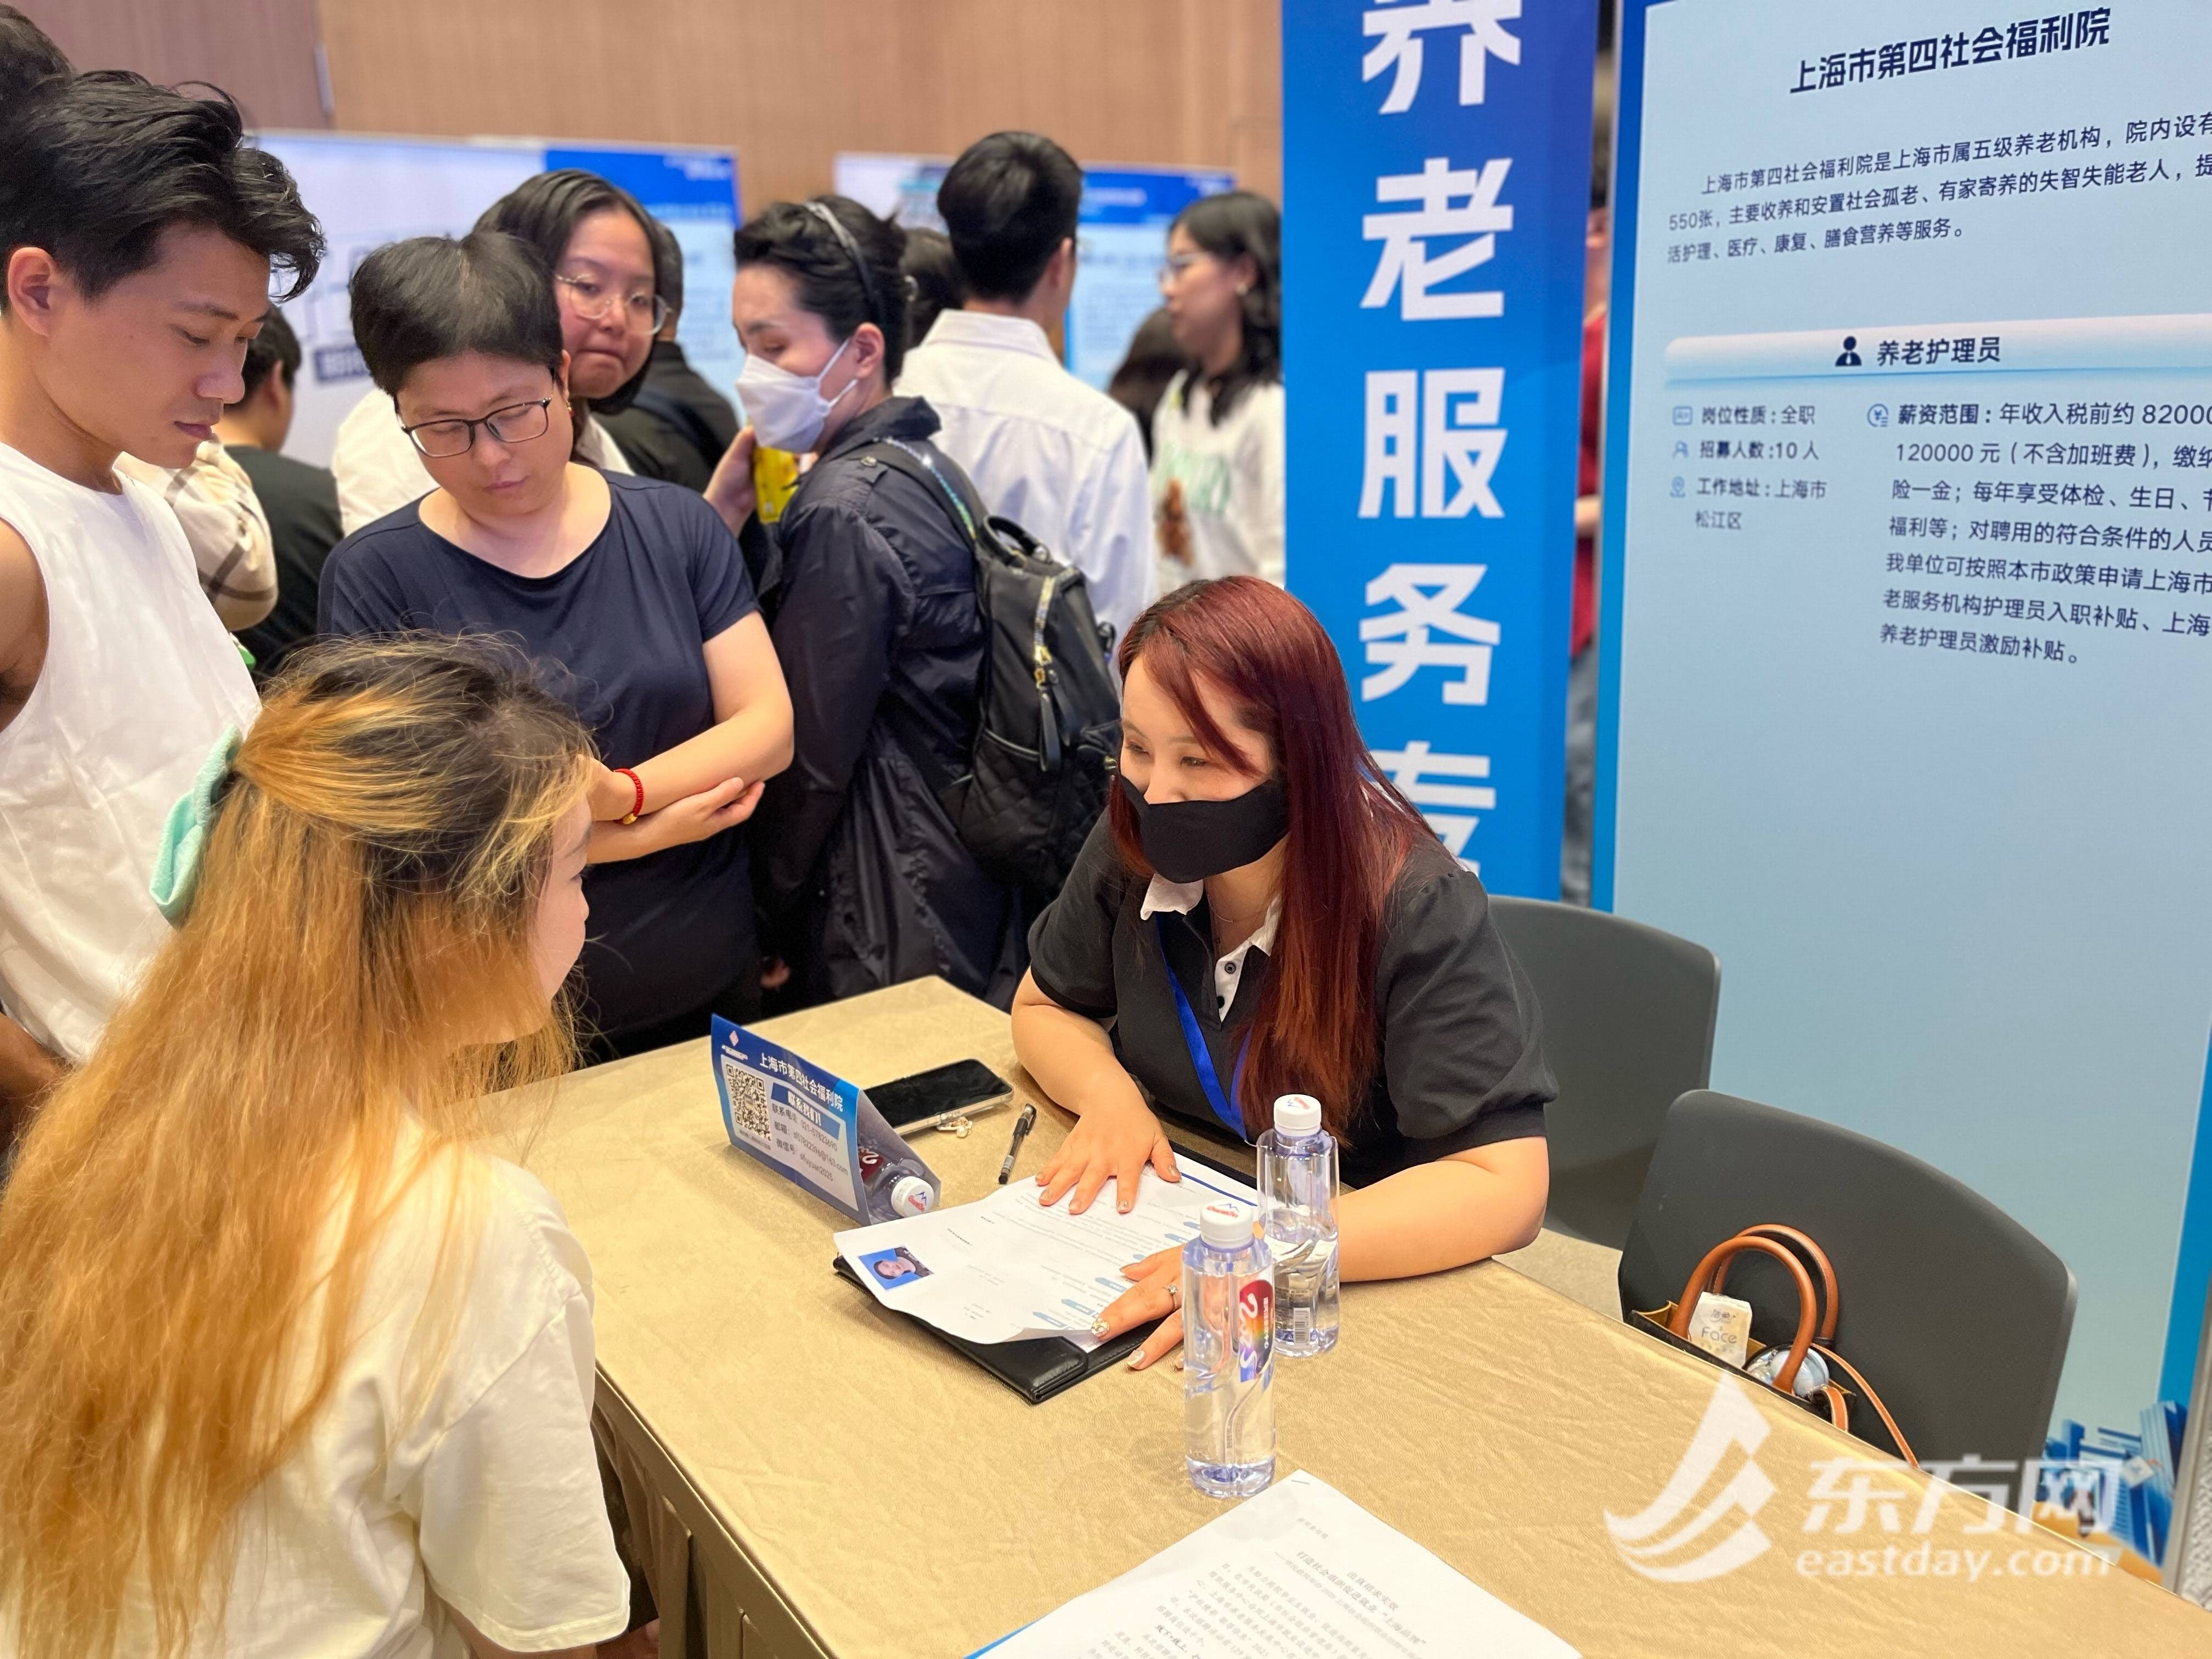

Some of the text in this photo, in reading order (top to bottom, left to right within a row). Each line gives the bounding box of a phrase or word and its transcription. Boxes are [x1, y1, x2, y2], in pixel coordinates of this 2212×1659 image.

[1790, 7, 2111, 94] 上海市第四社会福利院
[1877, 336, 2002, 366] 养老护理员
[1695, 510, 1742, 531] 松江区
[1886, 552, 2212, 595] 我单位可按照本市政策申请上海市
[1880, 623, 2078, 664] 养老护理员激励补贴。
[759, 1052, 844, 1112] 上海市第四社会福利院
[1701, 1326, 1737, 1344] Face
